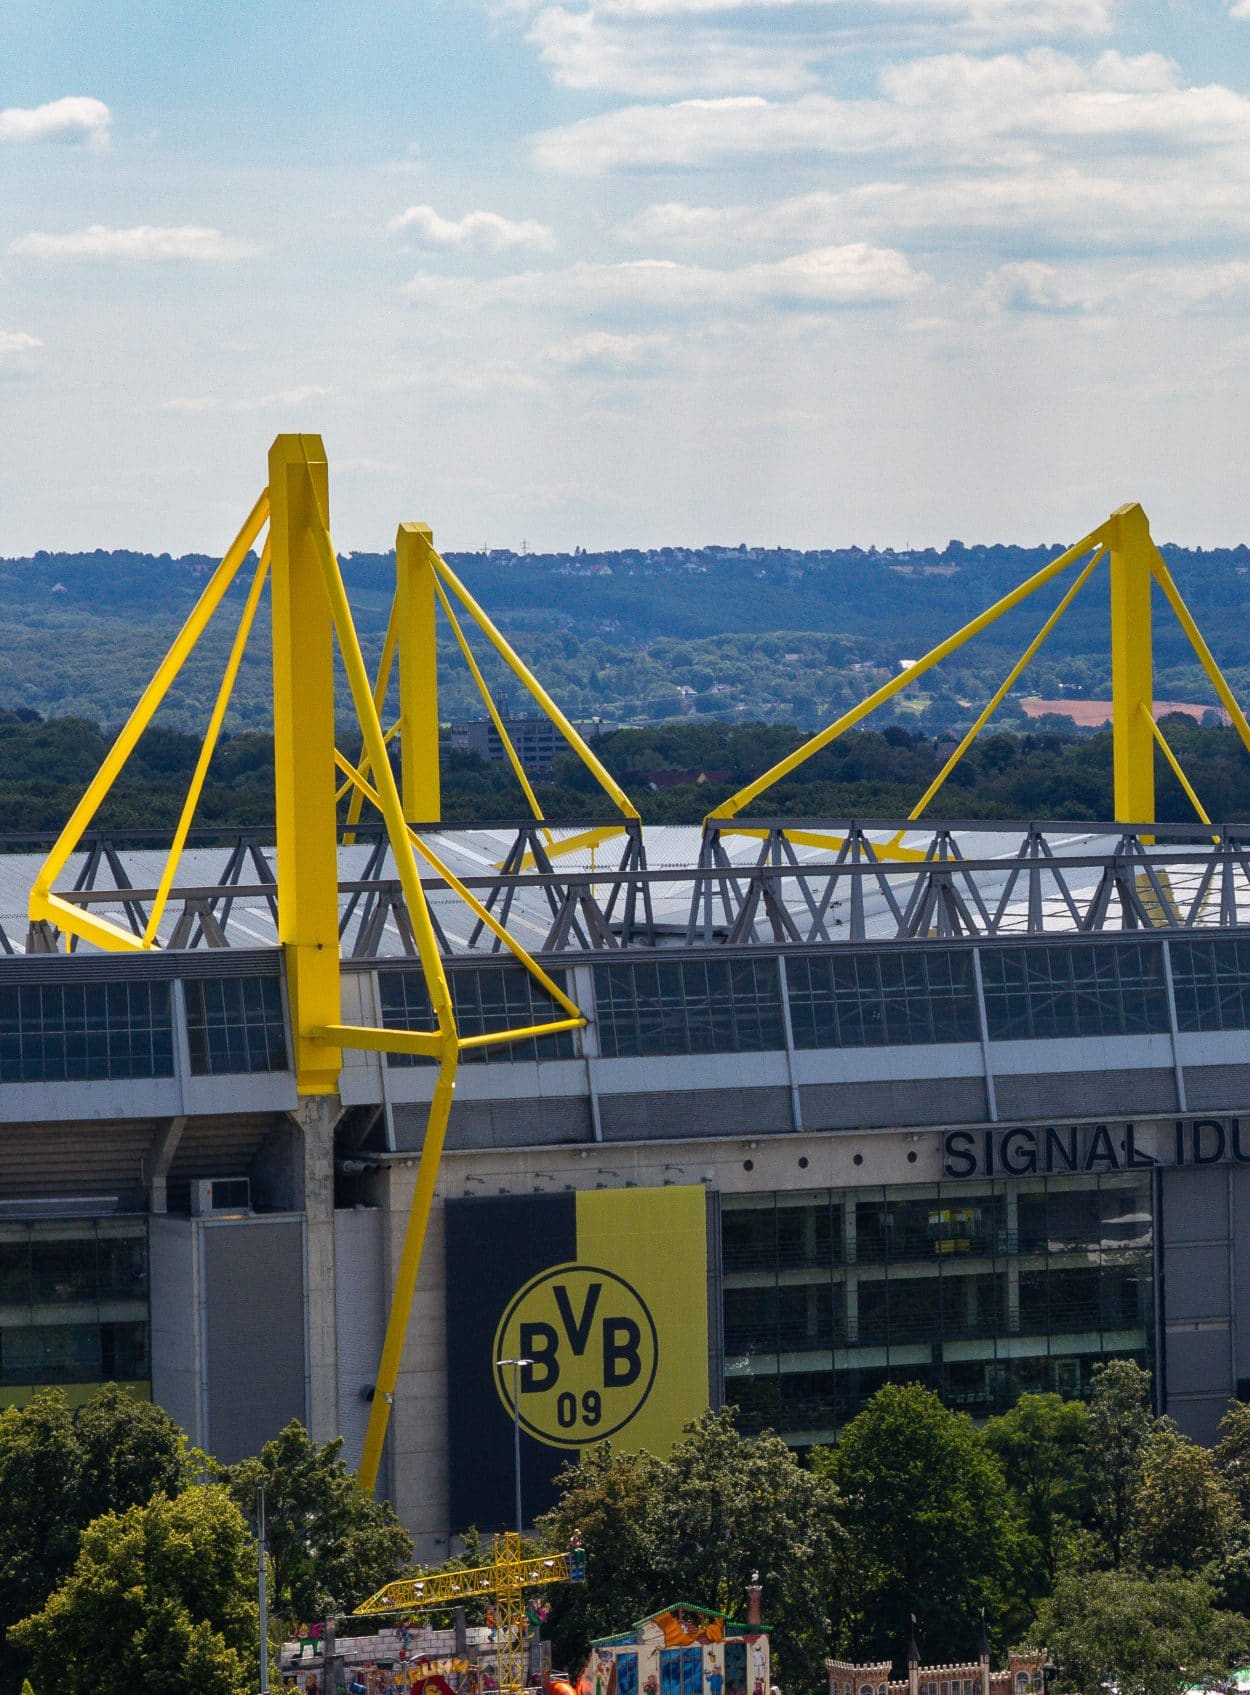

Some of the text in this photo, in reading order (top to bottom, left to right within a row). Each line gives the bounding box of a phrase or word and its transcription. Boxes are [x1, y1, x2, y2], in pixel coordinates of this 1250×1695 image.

[944, 1124, 1157, 1178] SIGNAL
[520, 1283, 642, 1393] BVB
[557, 1390, 602, 1428] 09
